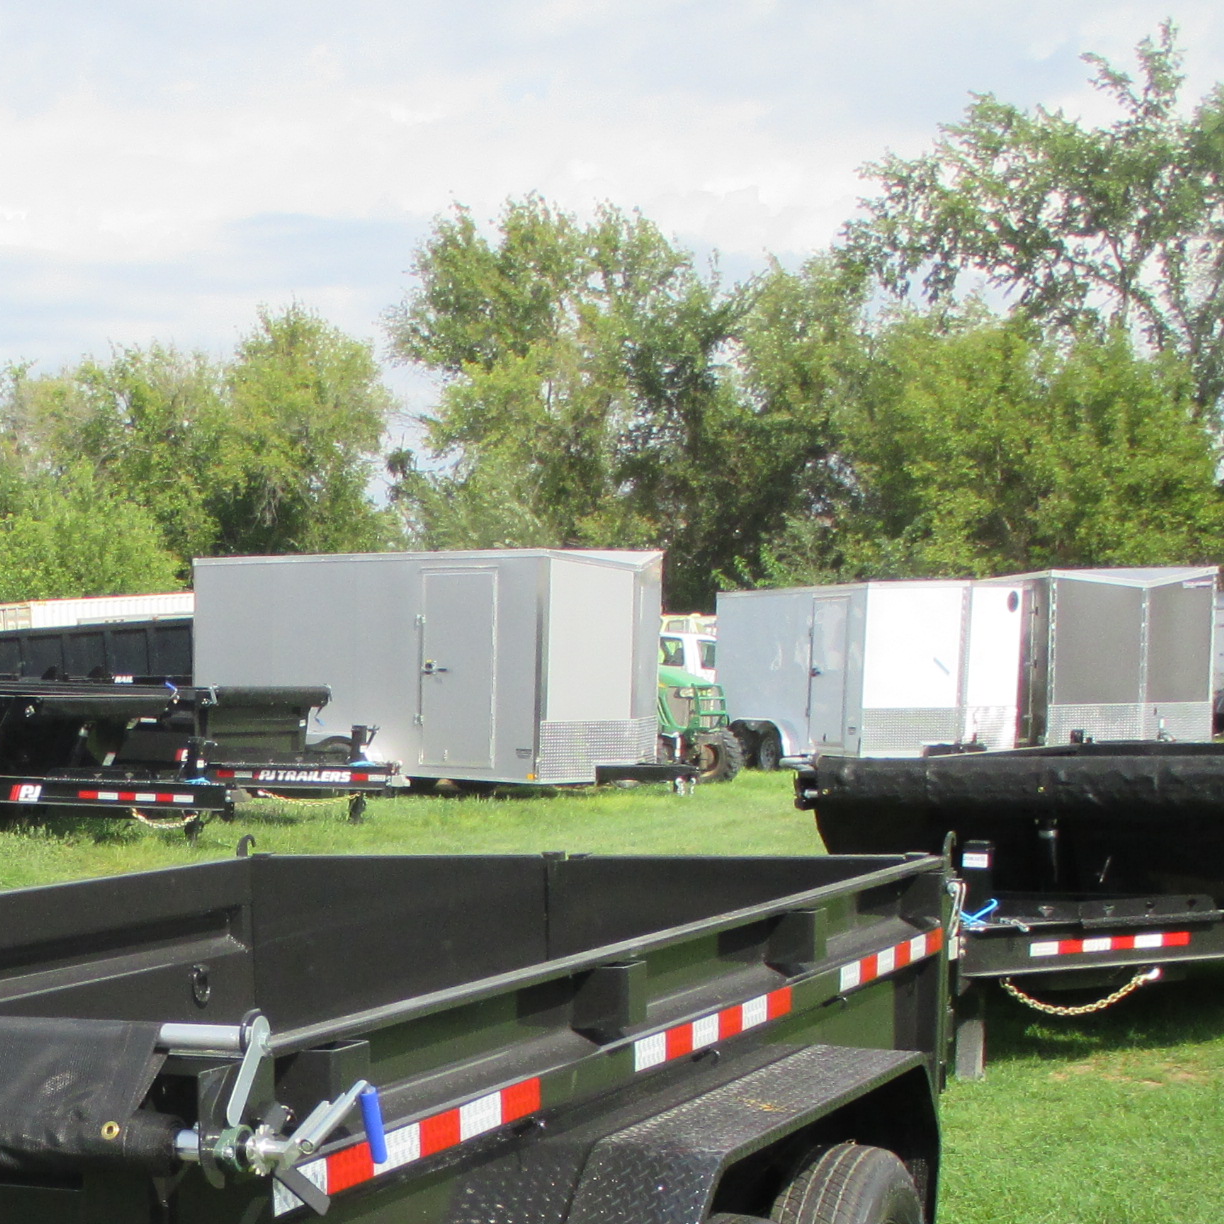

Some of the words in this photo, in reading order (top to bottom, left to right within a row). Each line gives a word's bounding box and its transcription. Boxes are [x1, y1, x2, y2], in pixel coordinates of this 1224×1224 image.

[258, 769, 276, 781] PJ
[277, 769, 352, 783] TRAILERS
[18, 784, 42, 799] PJ
